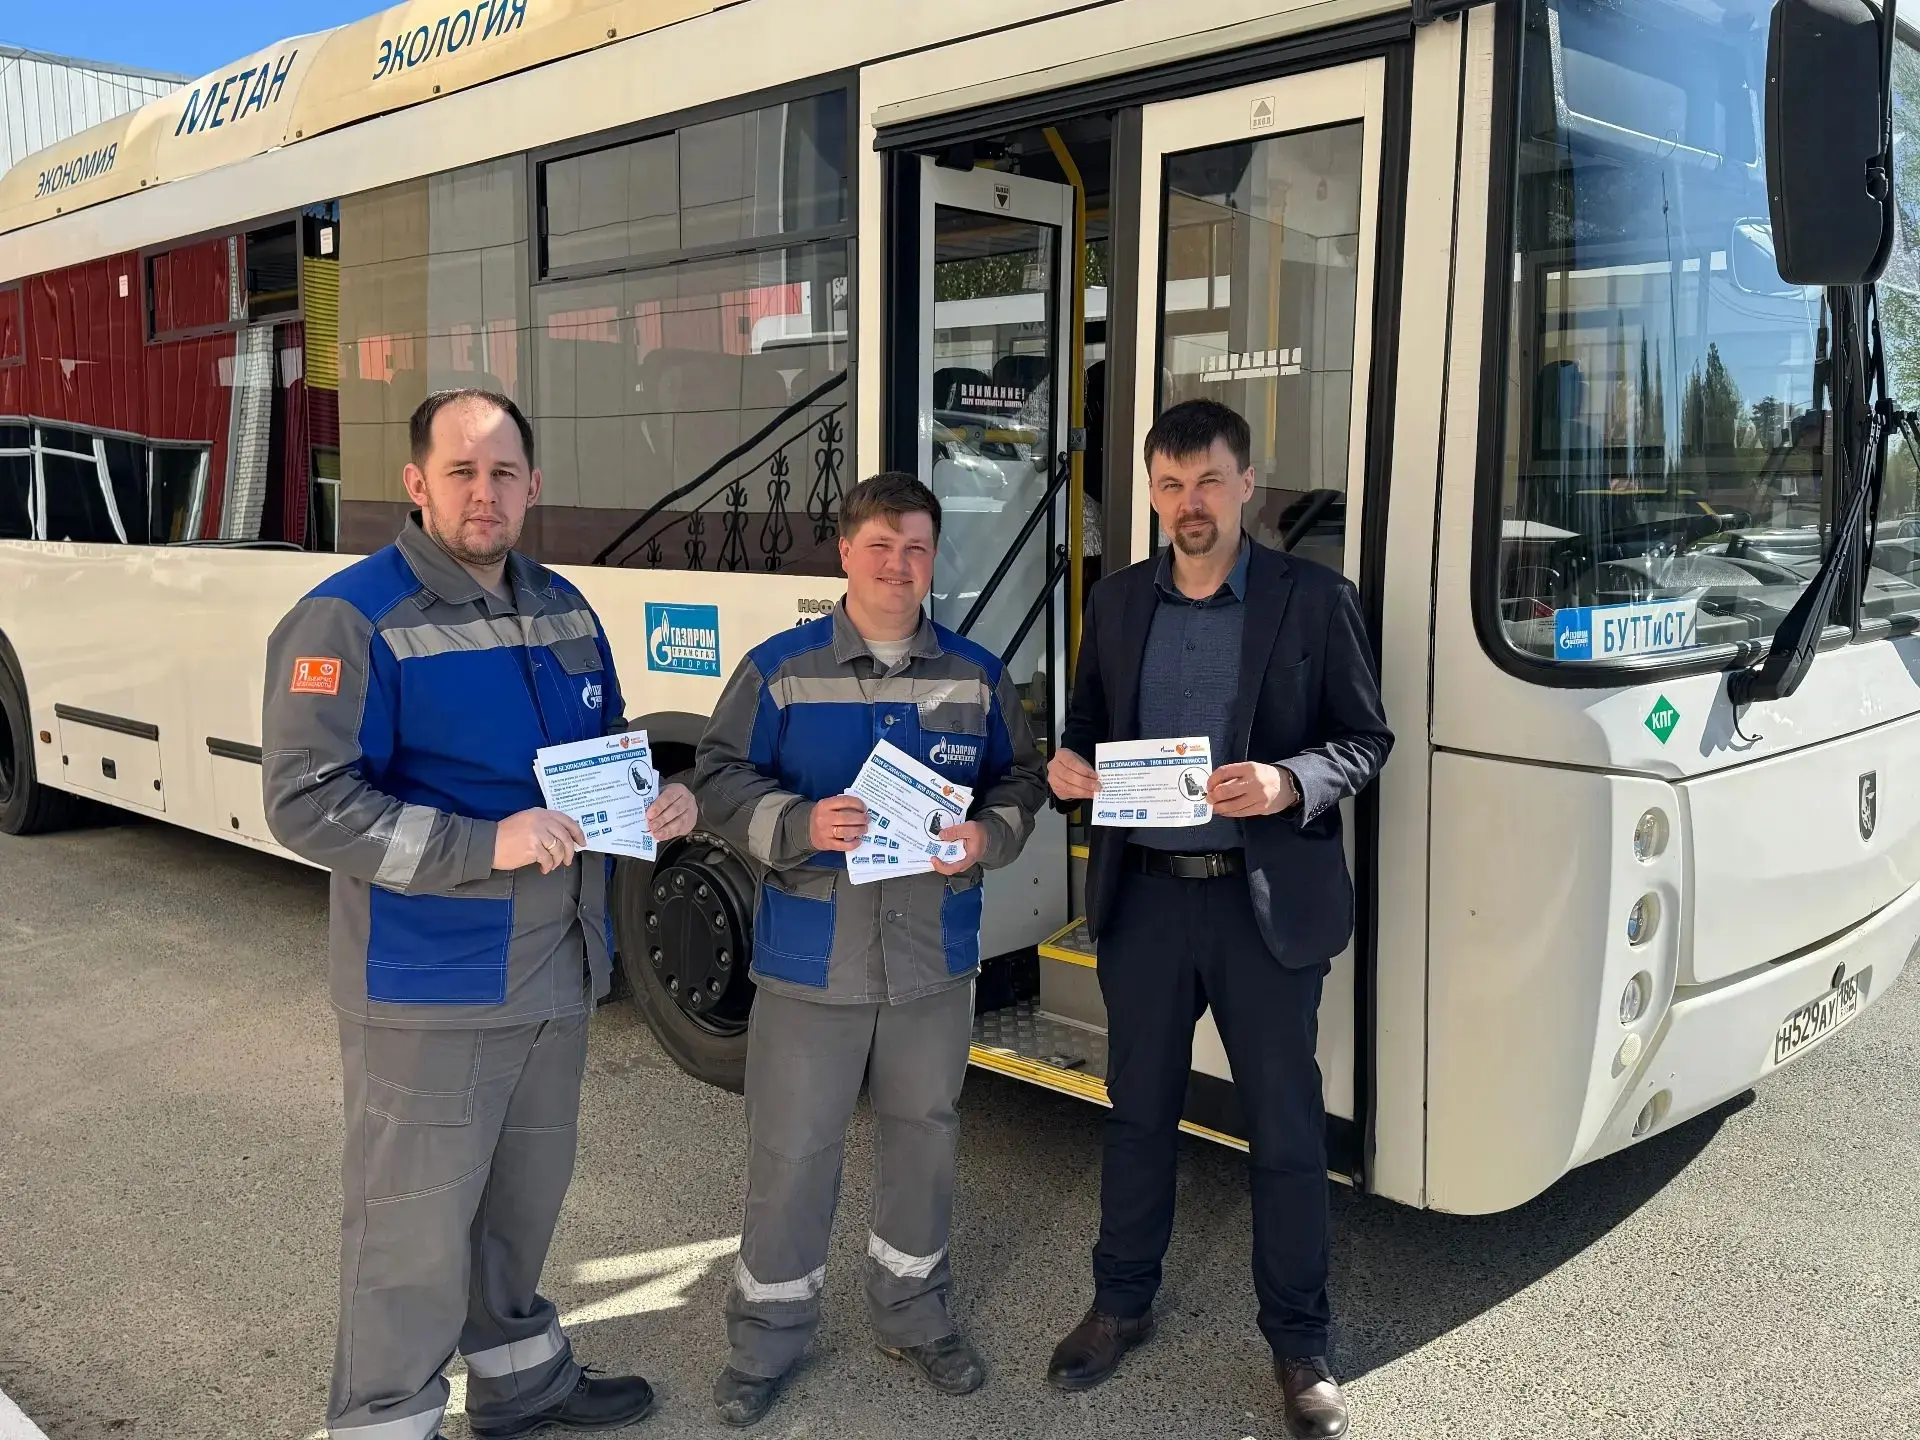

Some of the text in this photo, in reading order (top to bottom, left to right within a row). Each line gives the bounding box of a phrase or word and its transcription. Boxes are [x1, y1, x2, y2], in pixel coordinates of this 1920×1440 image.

[372, 0, 527, 80] ЭКОЛОГИЯ
[174, 49, 298, 136] МЕТАН
[34, 142, 118, 198] ЭКОНОМИЯ
[961, 383, 1025, 400] ВНИМАНИЕ!
[671, 627, 716, 648] ГАЗПРОМ
[1604, 612, 1686, 653] БУТТиСТ
[672, 647, 716, 659] ТРАНСГАЗ
[298, 663, 309, 681] Я
[672, 658, 717, 671] ЮГОРСК
[1652, 709, 1674, 729] КПГ
[947, 744, 977, 756] ГАЗПРОМ
[1781, 977, 1856, 1055] Н529АУ 186
